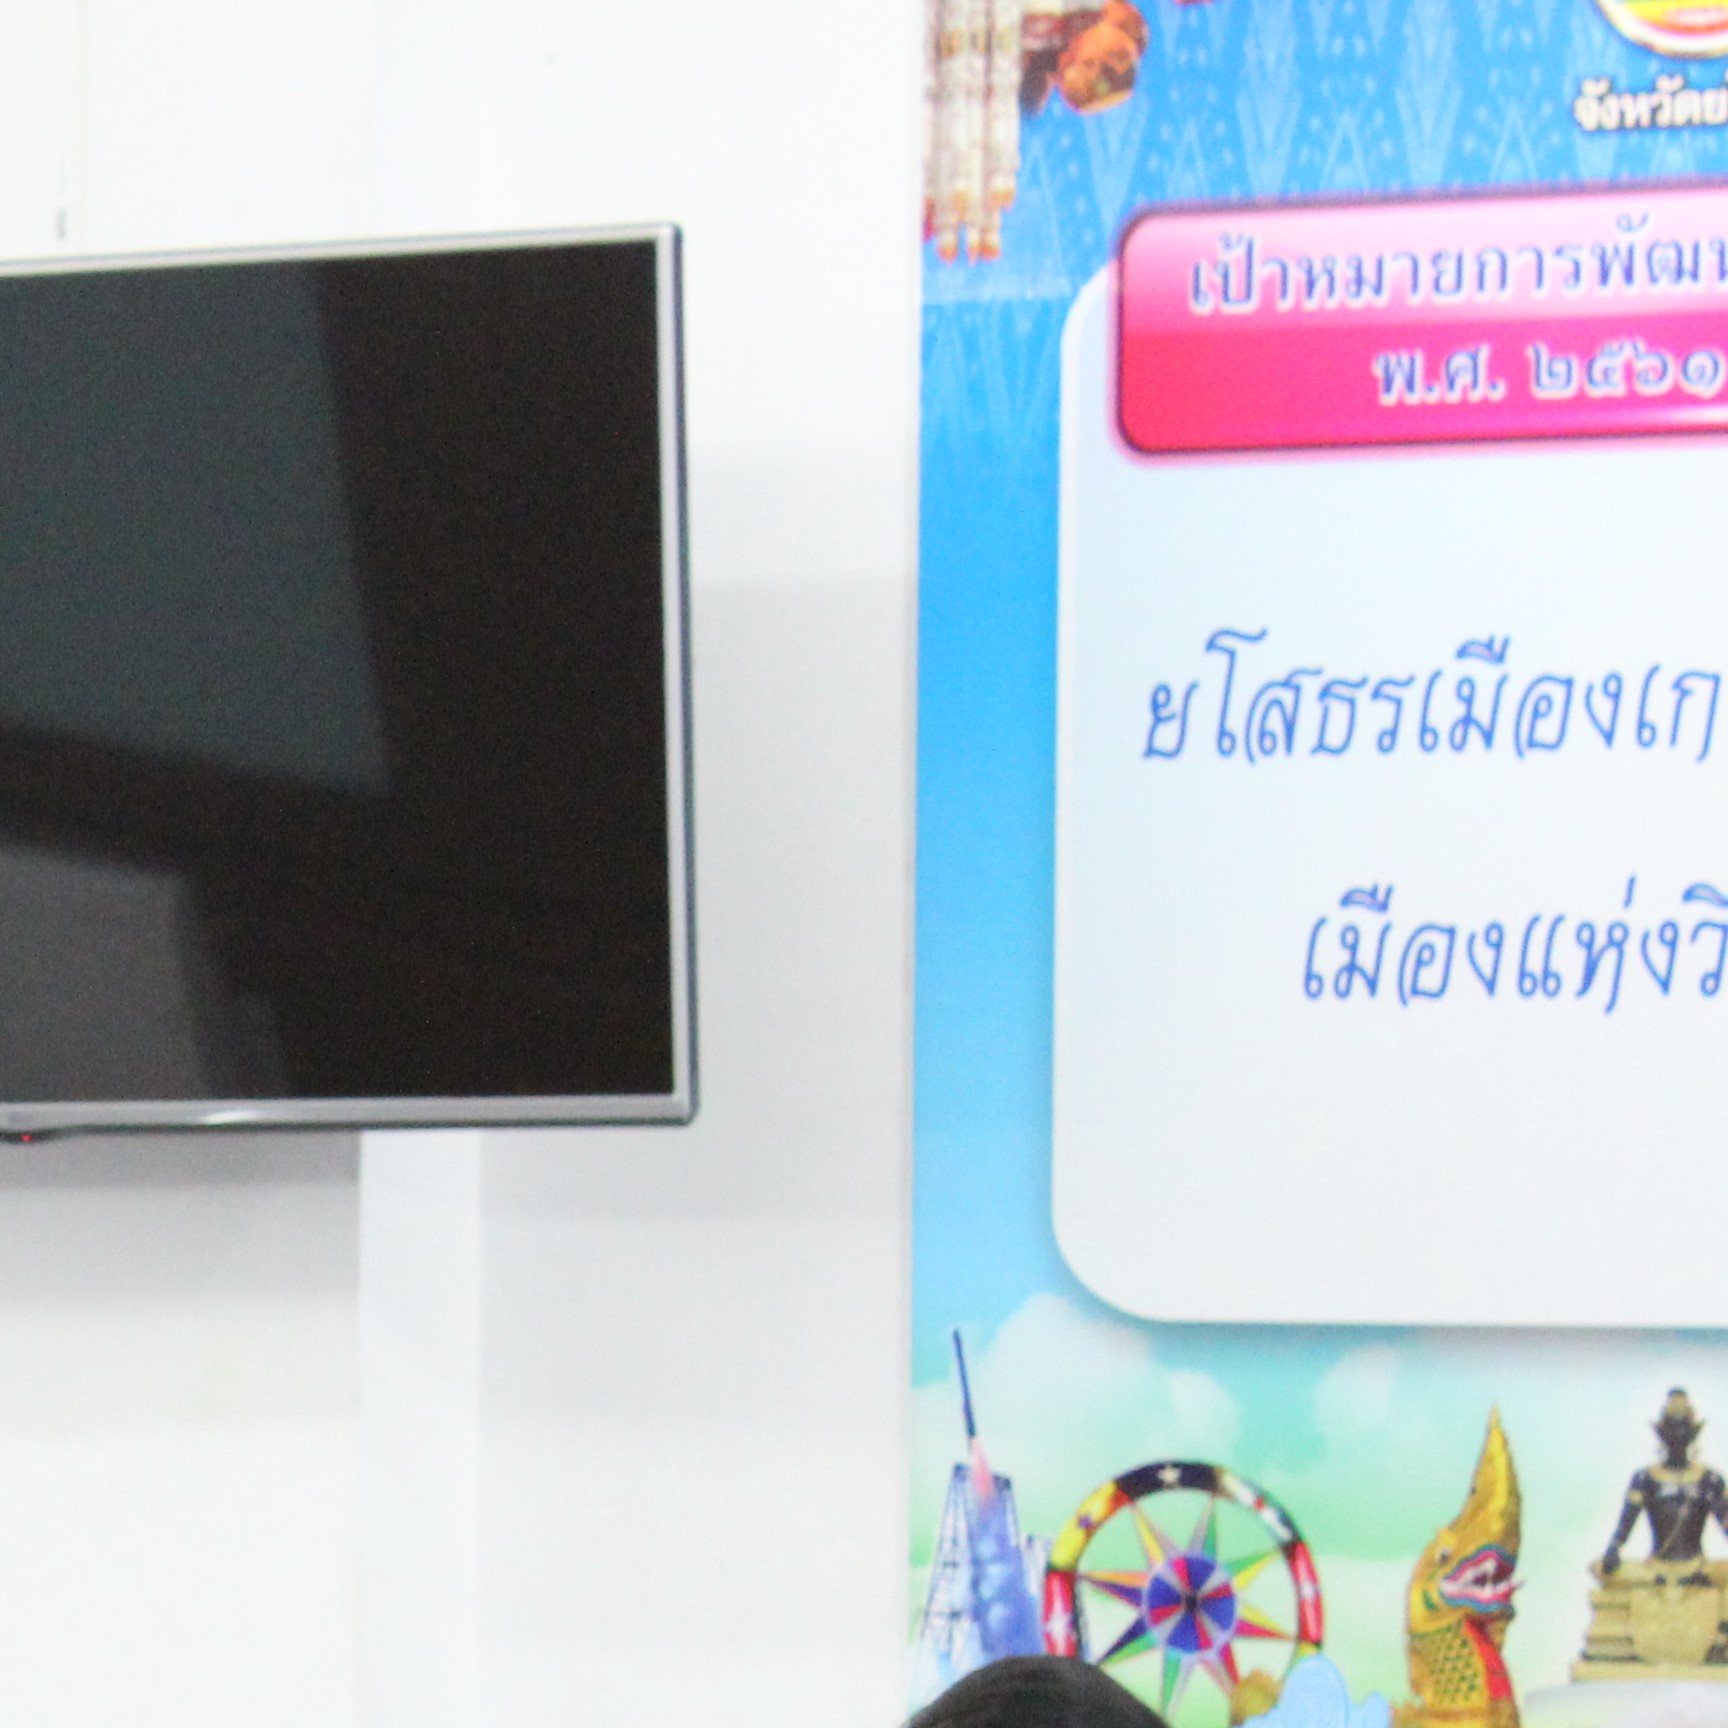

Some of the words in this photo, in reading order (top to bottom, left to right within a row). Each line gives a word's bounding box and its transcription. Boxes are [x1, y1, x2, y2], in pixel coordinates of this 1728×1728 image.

[1573, 73, 1728, 132] จังหวัดย
[1374, 344, 1506, 403] พ.ศ.
